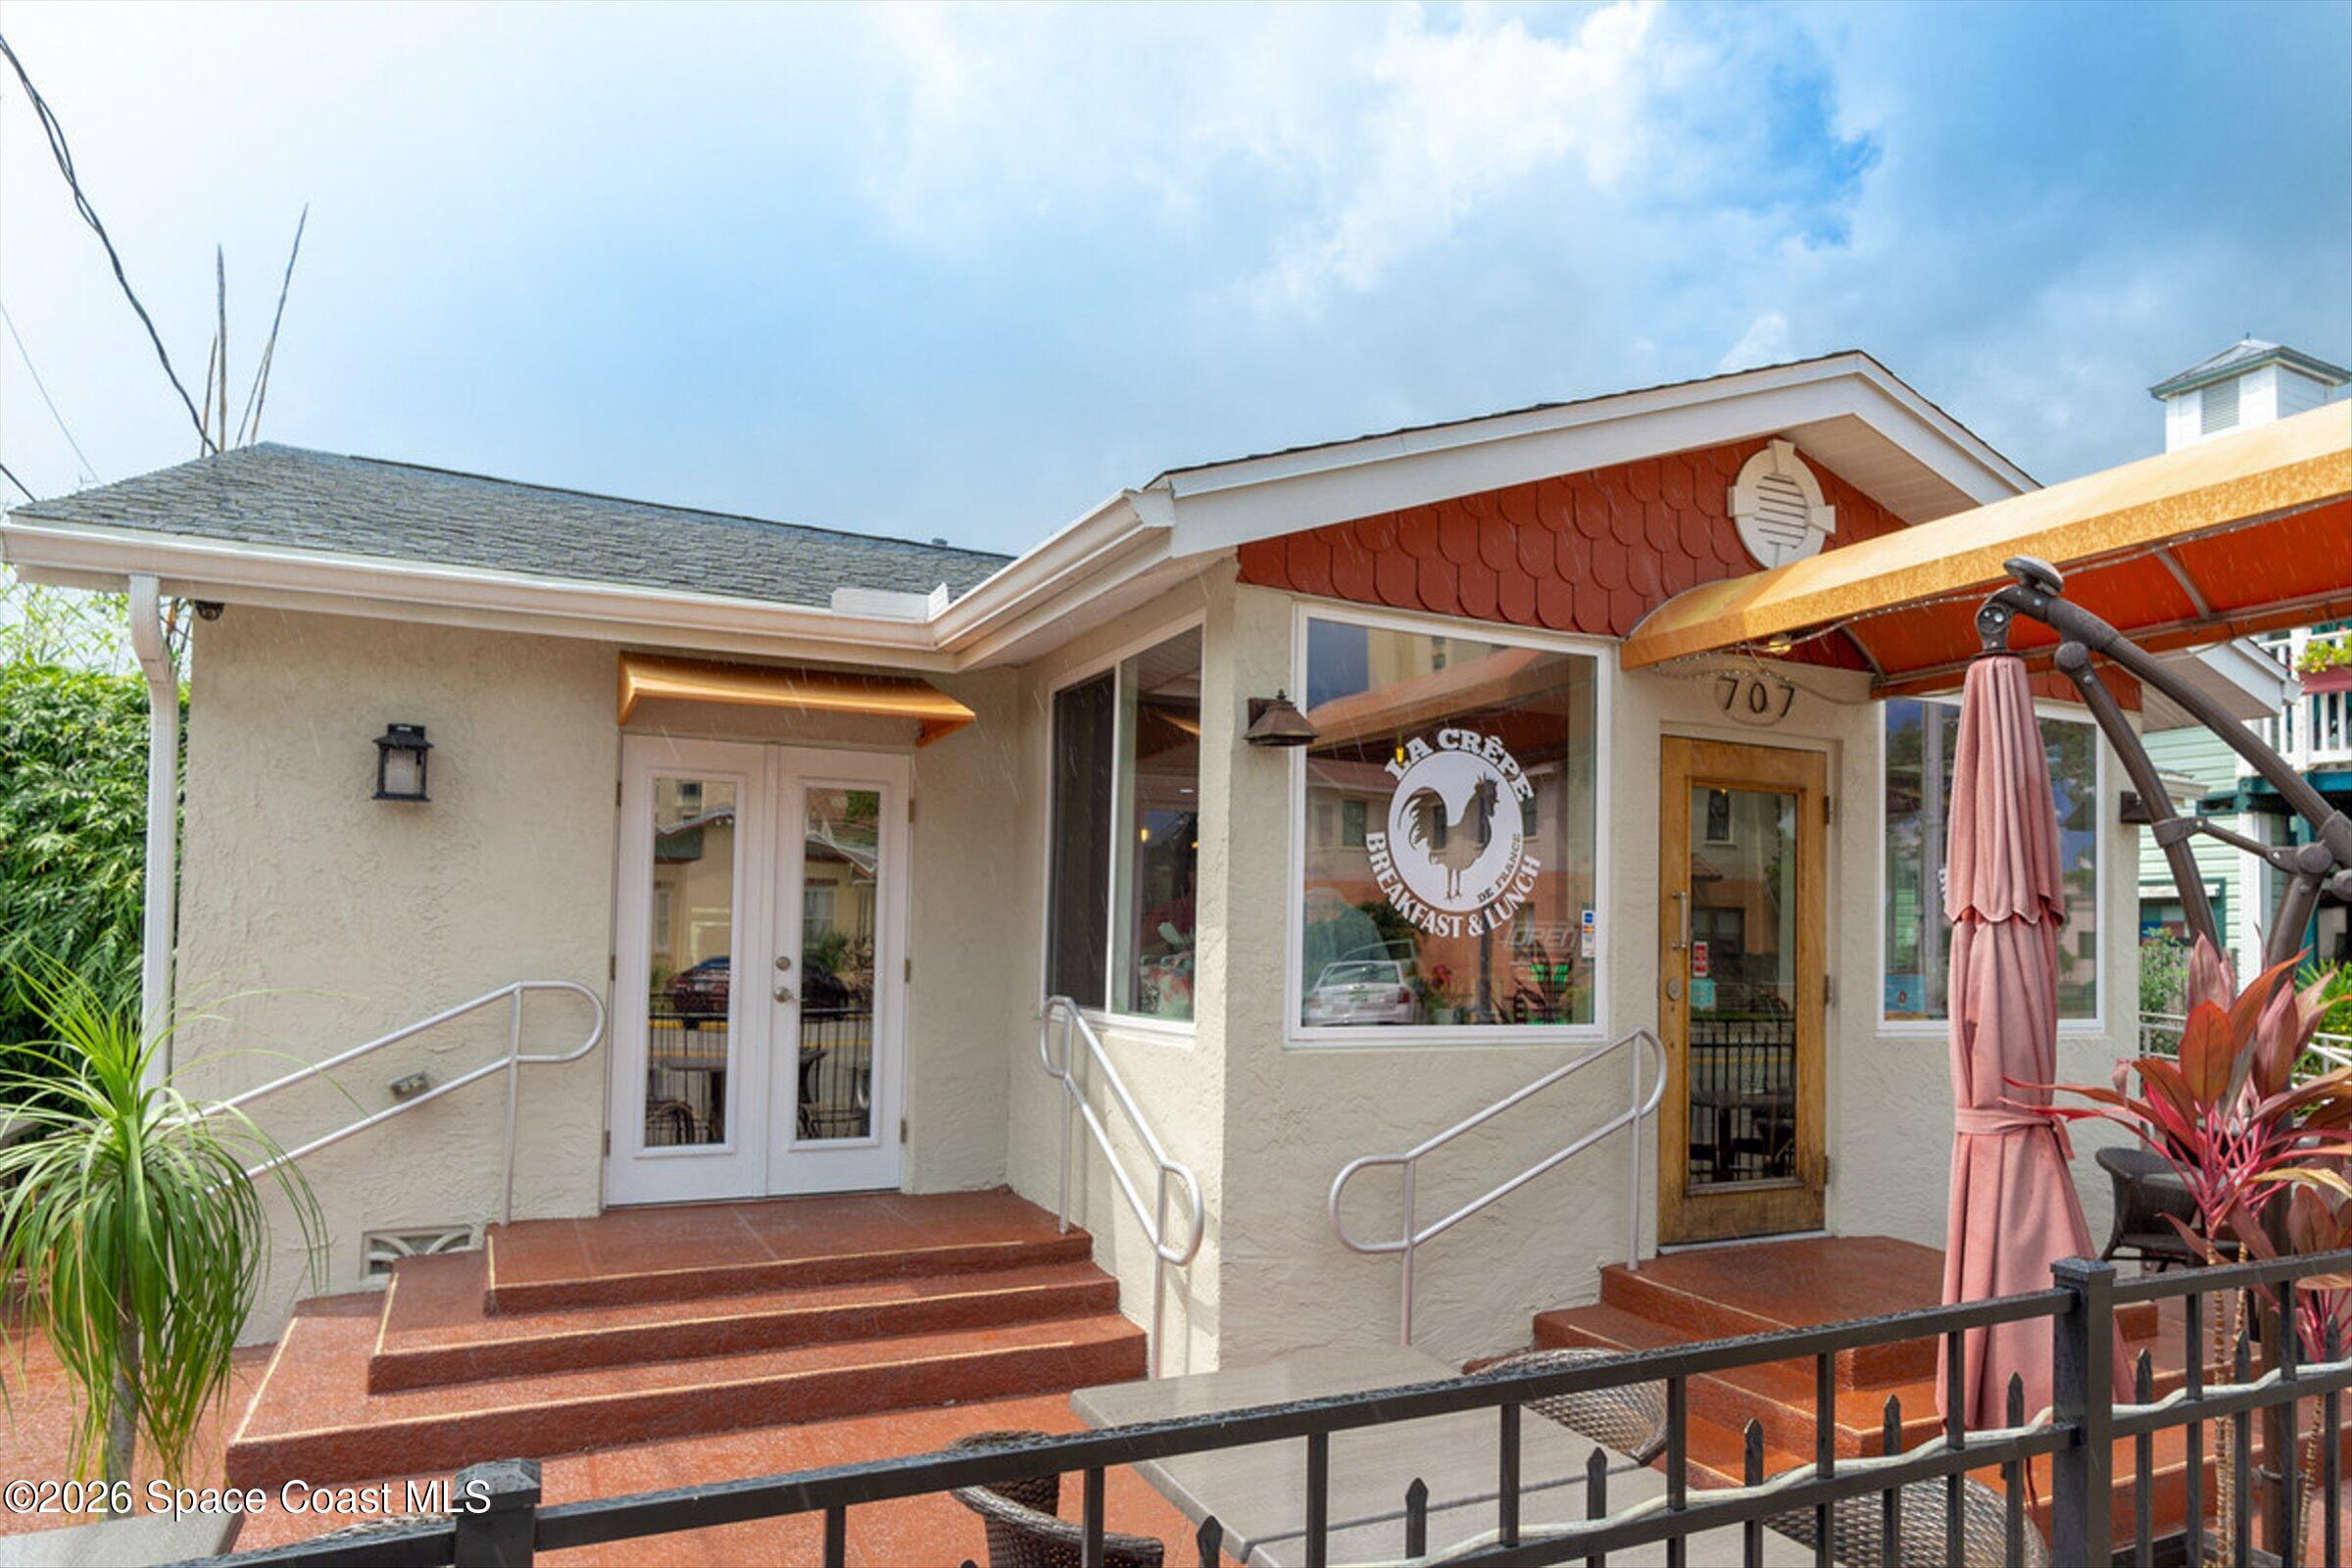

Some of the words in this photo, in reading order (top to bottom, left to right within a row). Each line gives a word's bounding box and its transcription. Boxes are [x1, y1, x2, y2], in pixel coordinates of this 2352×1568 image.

[1718, 676, 1794, 717] 707
[1384, 737, 1434, 781] LA
[1437, 728, 1535, 802] CRÊPE
[1365, 832, 1463, 939] BREAKFAST
[1467, 912, 1485, 938] &
[1484, 854, 1542, 930] LUNCH
[1477, 887, 1494, 903] DE
[1494, 833, 1520, 889] FRANCE
